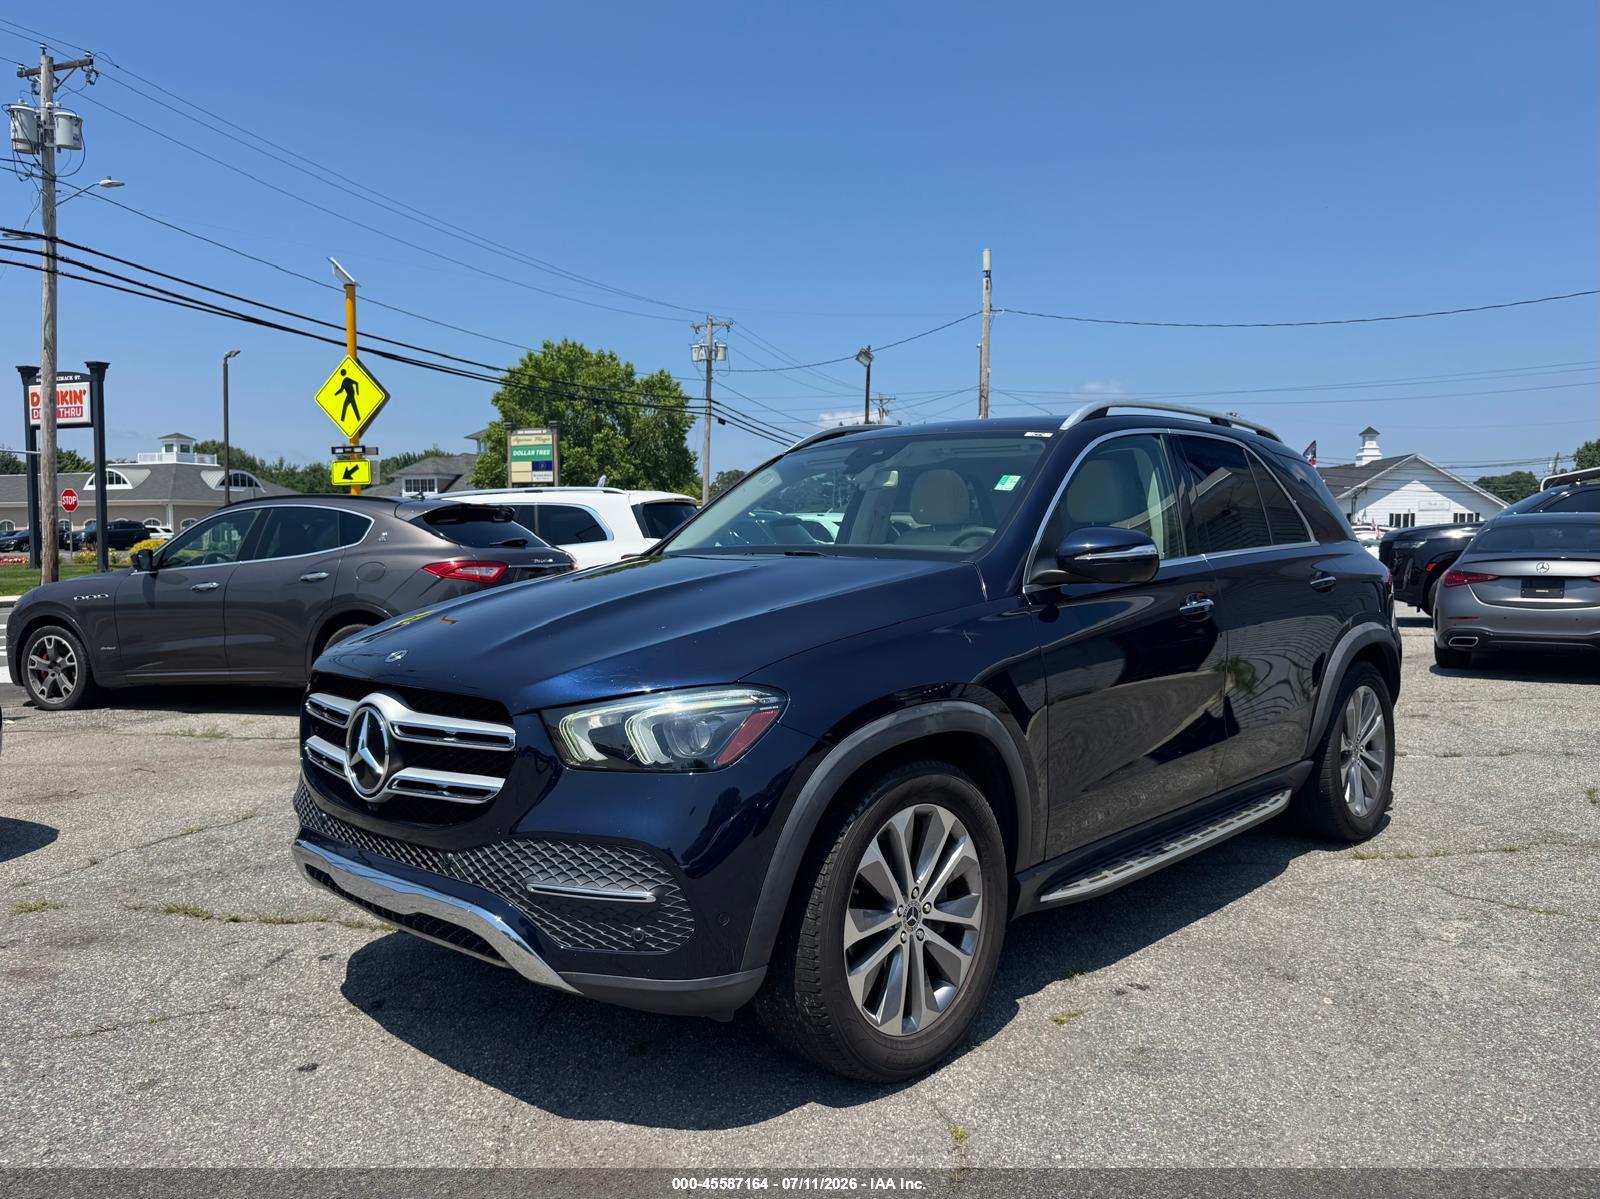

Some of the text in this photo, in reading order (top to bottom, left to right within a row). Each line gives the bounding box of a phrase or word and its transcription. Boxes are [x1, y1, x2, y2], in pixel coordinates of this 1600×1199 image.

[31, 389, 86, 406] DKIN'
[60, 407, 81, 417] THRU
[62, 496, 77, 505] STOP
